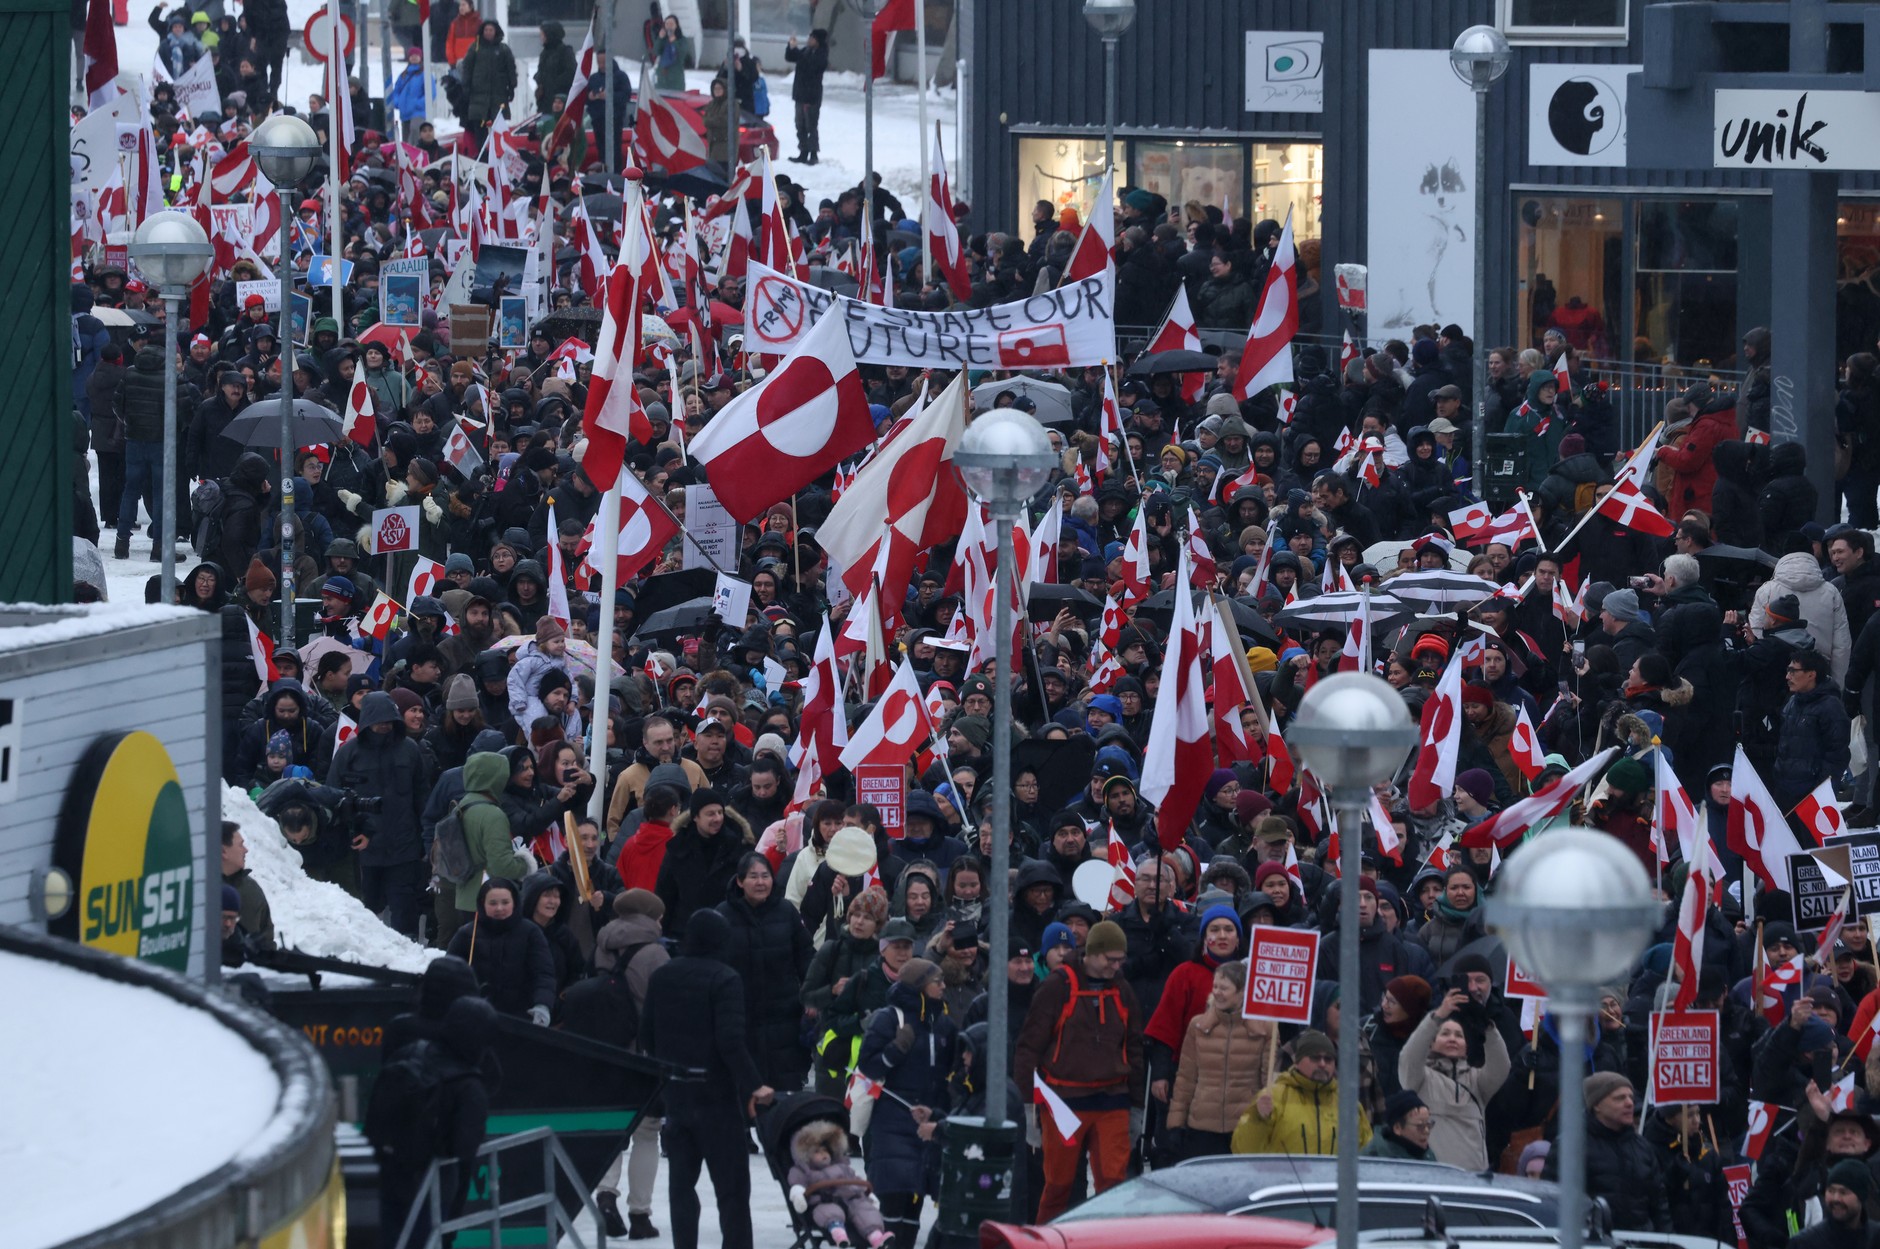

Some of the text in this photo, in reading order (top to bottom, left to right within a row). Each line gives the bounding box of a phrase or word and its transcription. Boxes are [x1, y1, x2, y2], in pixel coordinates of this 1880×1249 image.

[1721, 91, 1829, 164] unik
[758, 285, 795, 333] TRUMP
[881, 306, 1012, 334] SHAPE
[1023, 278, 1110, 324] OUR
[862, 779, 899, 789] GREENLAND
[871, 793, 884, 803] NOT
[886, 793, 899, 803] FOR
[1852, 846, 1877, 858] NLAND
[1852, 864, 1862, 875] OT
[1800, 883, 1808, 893] IS
[1811, 881, 1827, 892] NOT
[85, 866, 191, 942] SUNSET
[141, 926, 187, 957] Boulevard
[1260, 944, 1308, 959] GREENLAND
[1257, 962, 1306, 977] IS NOT FOR
[1255, 978, 1304, 1005] SALE!
[1660, 1029, 1709, 1039] GREENLAND
[1660, 1046, 1709, 1057] IS NOT FOR
[1660, 1063, 1709, 1086] SALE!
